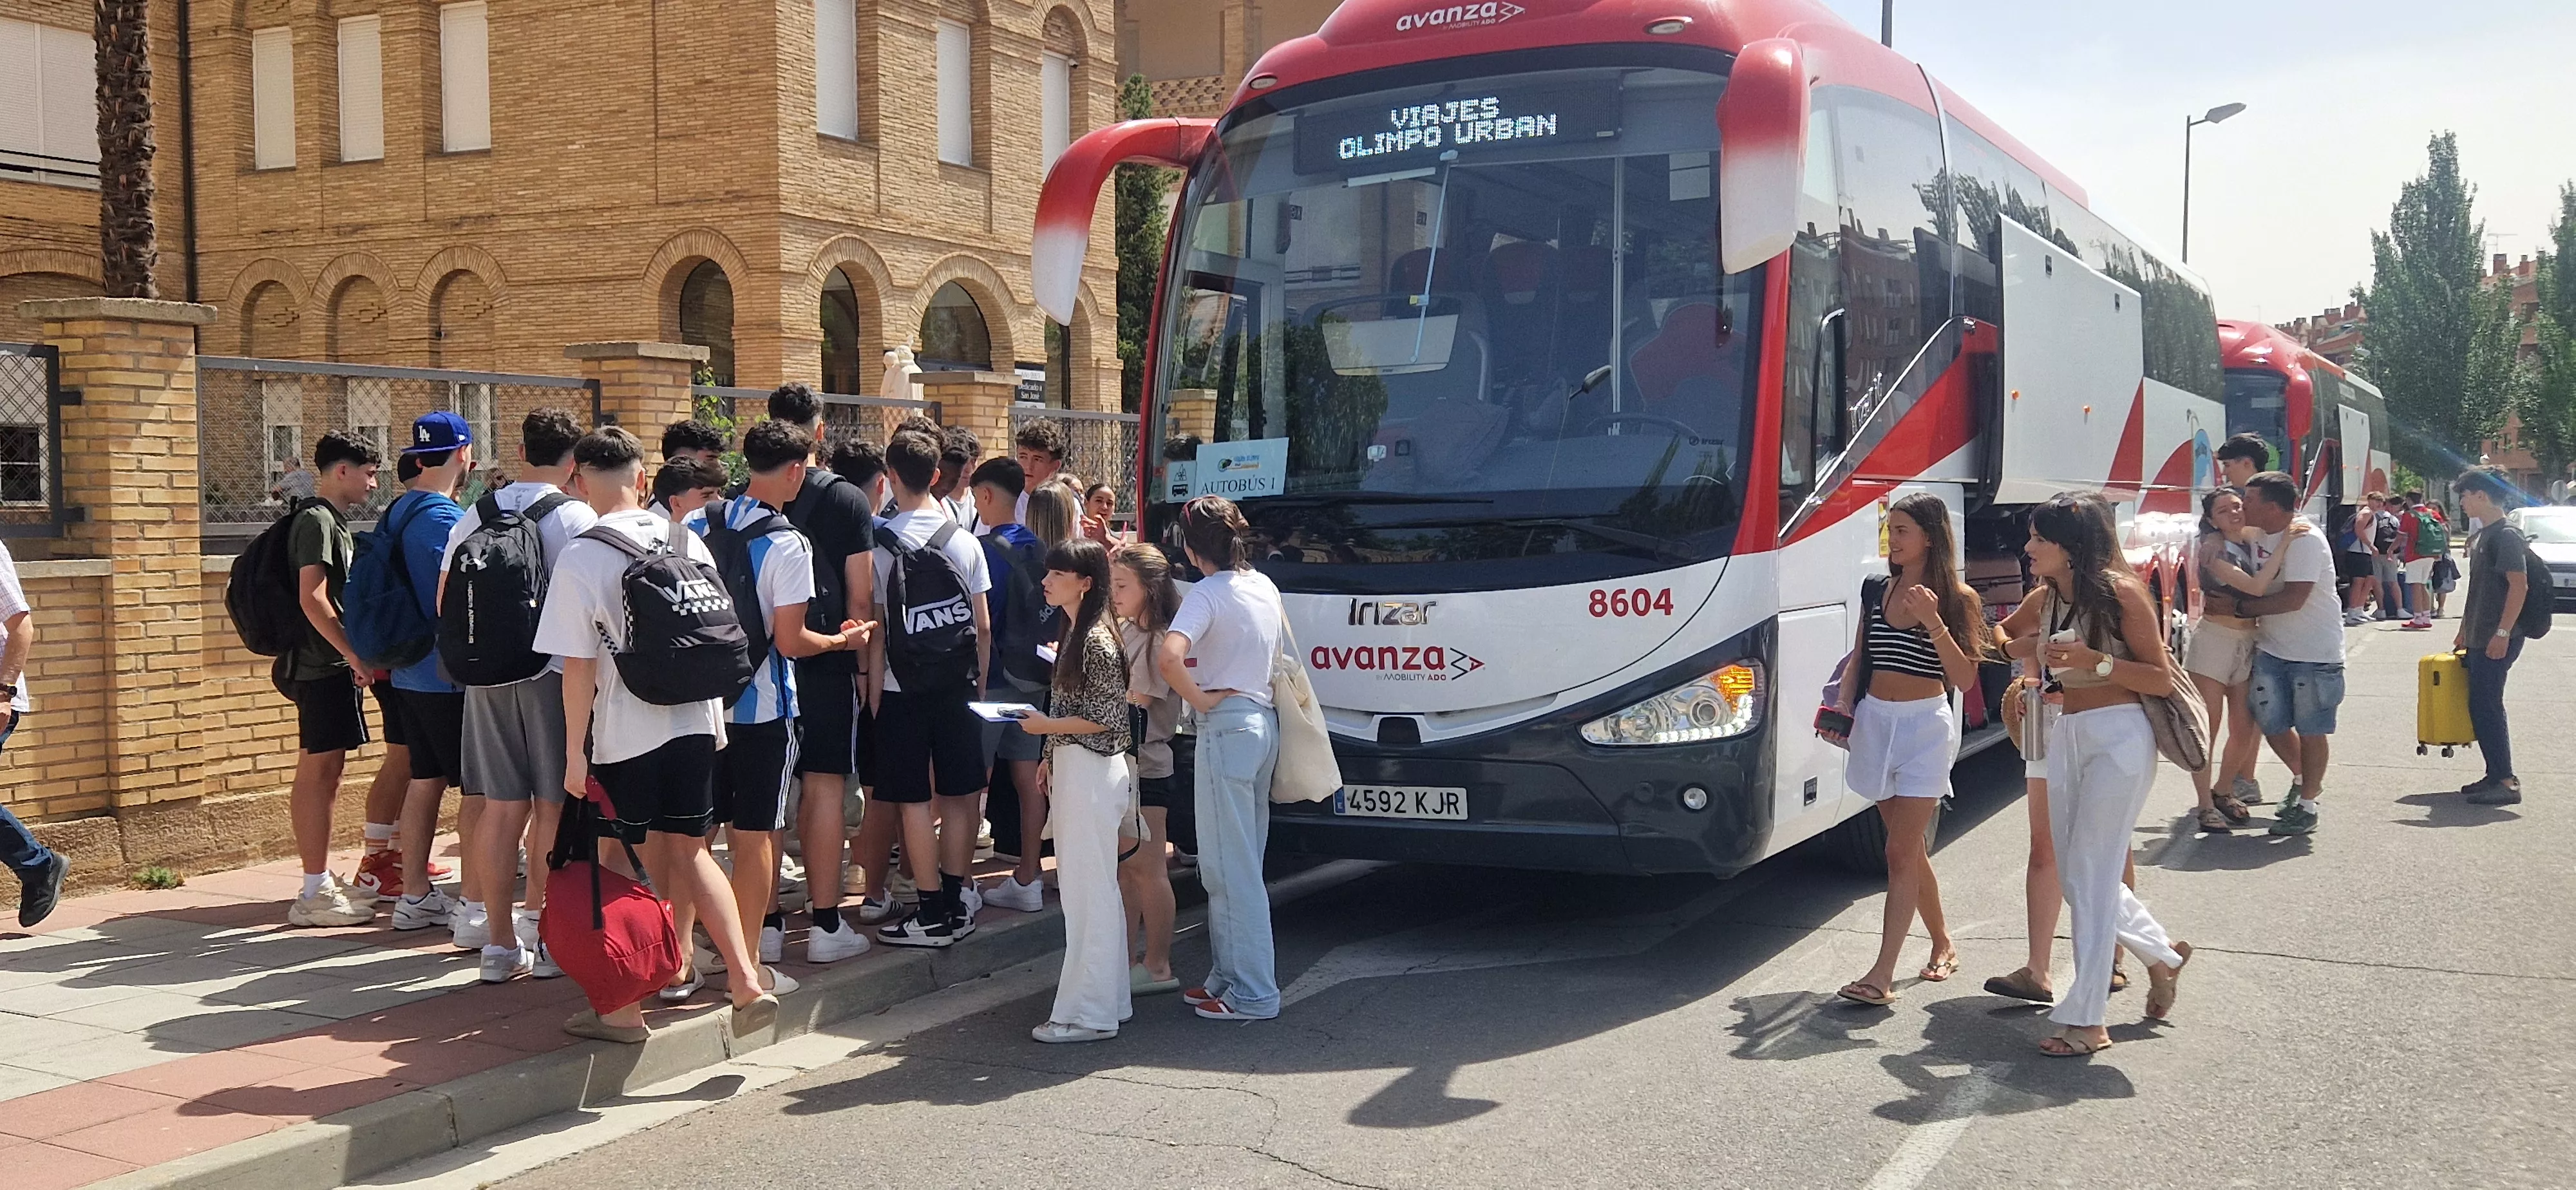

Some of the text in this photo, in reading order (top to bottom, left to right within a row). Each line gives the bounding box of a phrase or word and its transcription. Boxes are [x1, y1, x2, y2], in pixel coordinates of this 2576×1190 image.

[1396, 2, 1497, 31] avanza
[1390, 97, 1500, 129] VIAJES
[1339, 113, 1557, 159] OLIMPO URBAN
[418, 425, 431, 442] LA
[1200, 474, 1265, 495] AUTOBÚS
[663, 578, 720, 603] VANS
[1589, 588, 1674, 618] 8604
[902, 593, 972, 635] VANS
[1311, 646, 1446, 670] avanza
[1349, 789, 1460, 815] 4592 KJR
